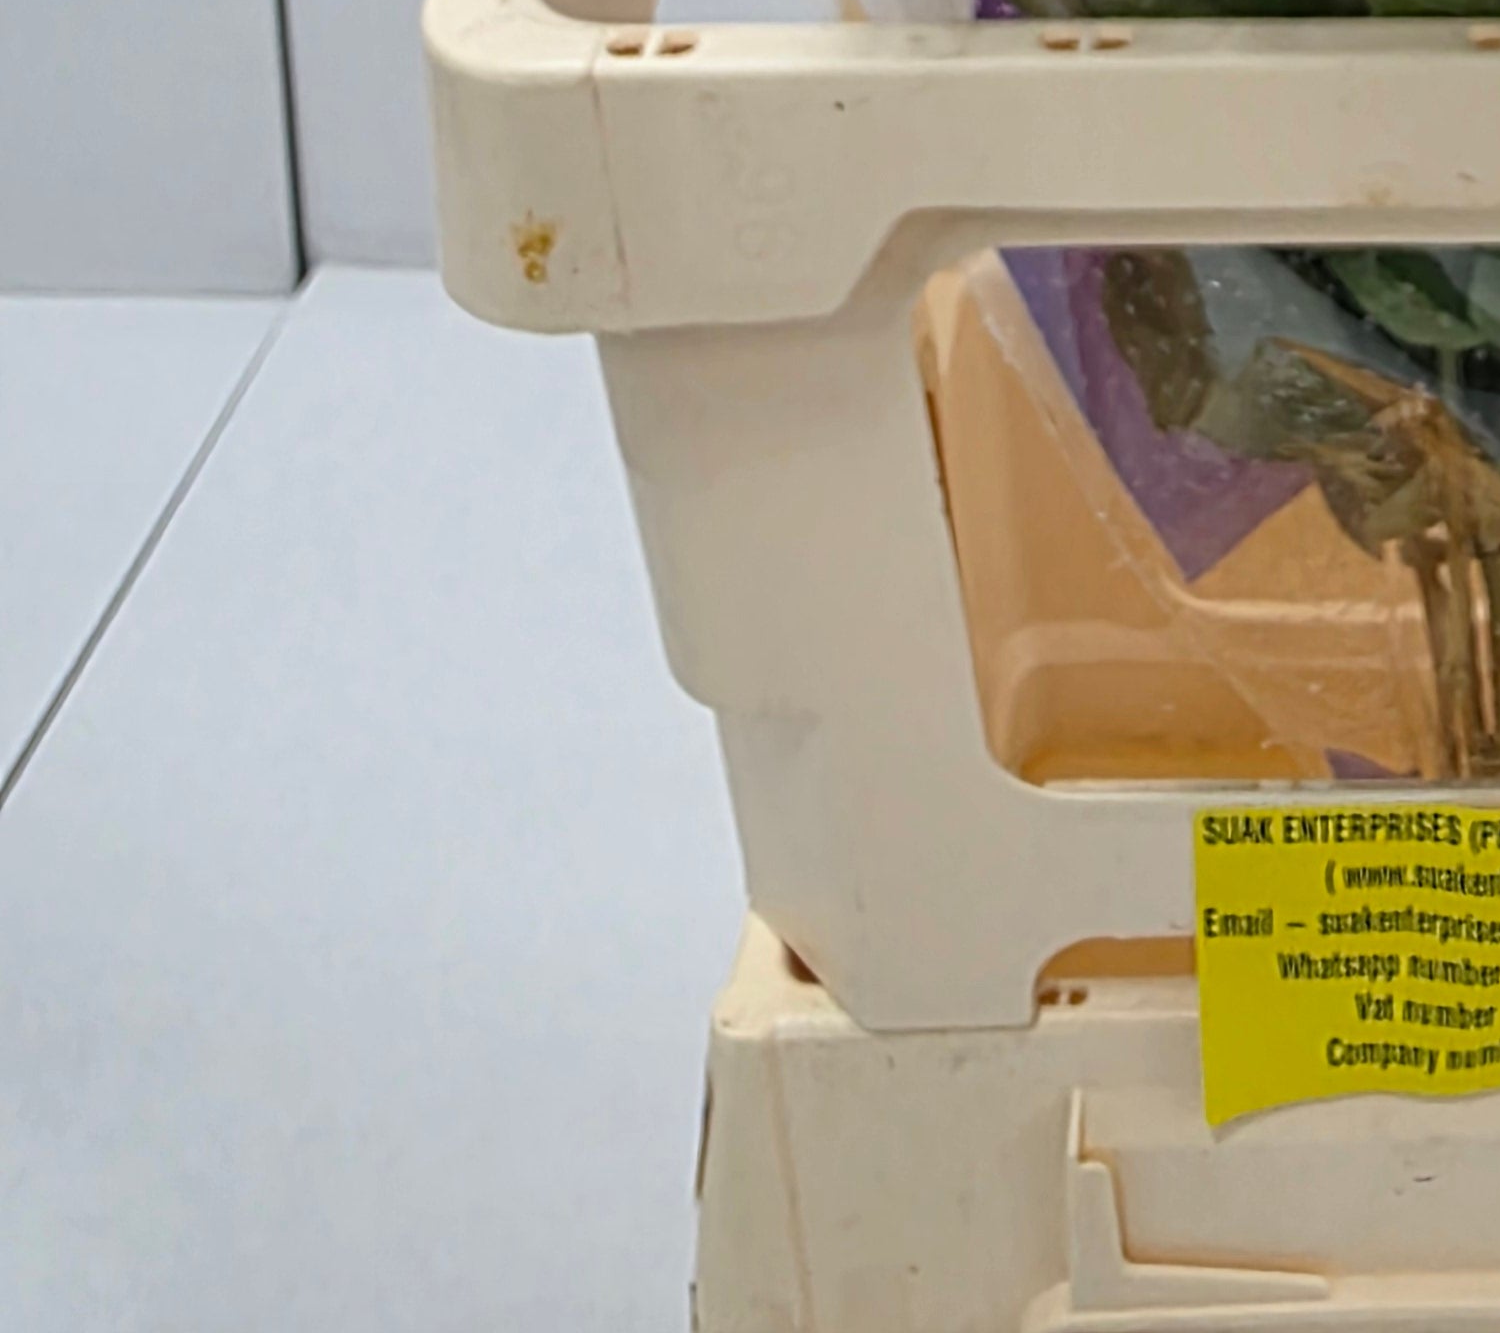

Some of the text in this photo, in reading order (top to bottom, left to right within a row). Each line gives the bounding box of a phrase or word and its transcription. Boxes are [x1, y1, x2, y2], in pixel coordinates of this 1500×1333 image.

[1202, 815, 1274, 846] SUAK
[1282, 811, 1462, 846] ENTERPRISES
[1203, 907, 1273, 938] Email
[1277, 951, 1400, 983] Whatsapp
[1354, 990, 1395, 1022] Vat
[1401, 999, 1497, 1030] number
[1326, 1037, 1439, 1075] Company
